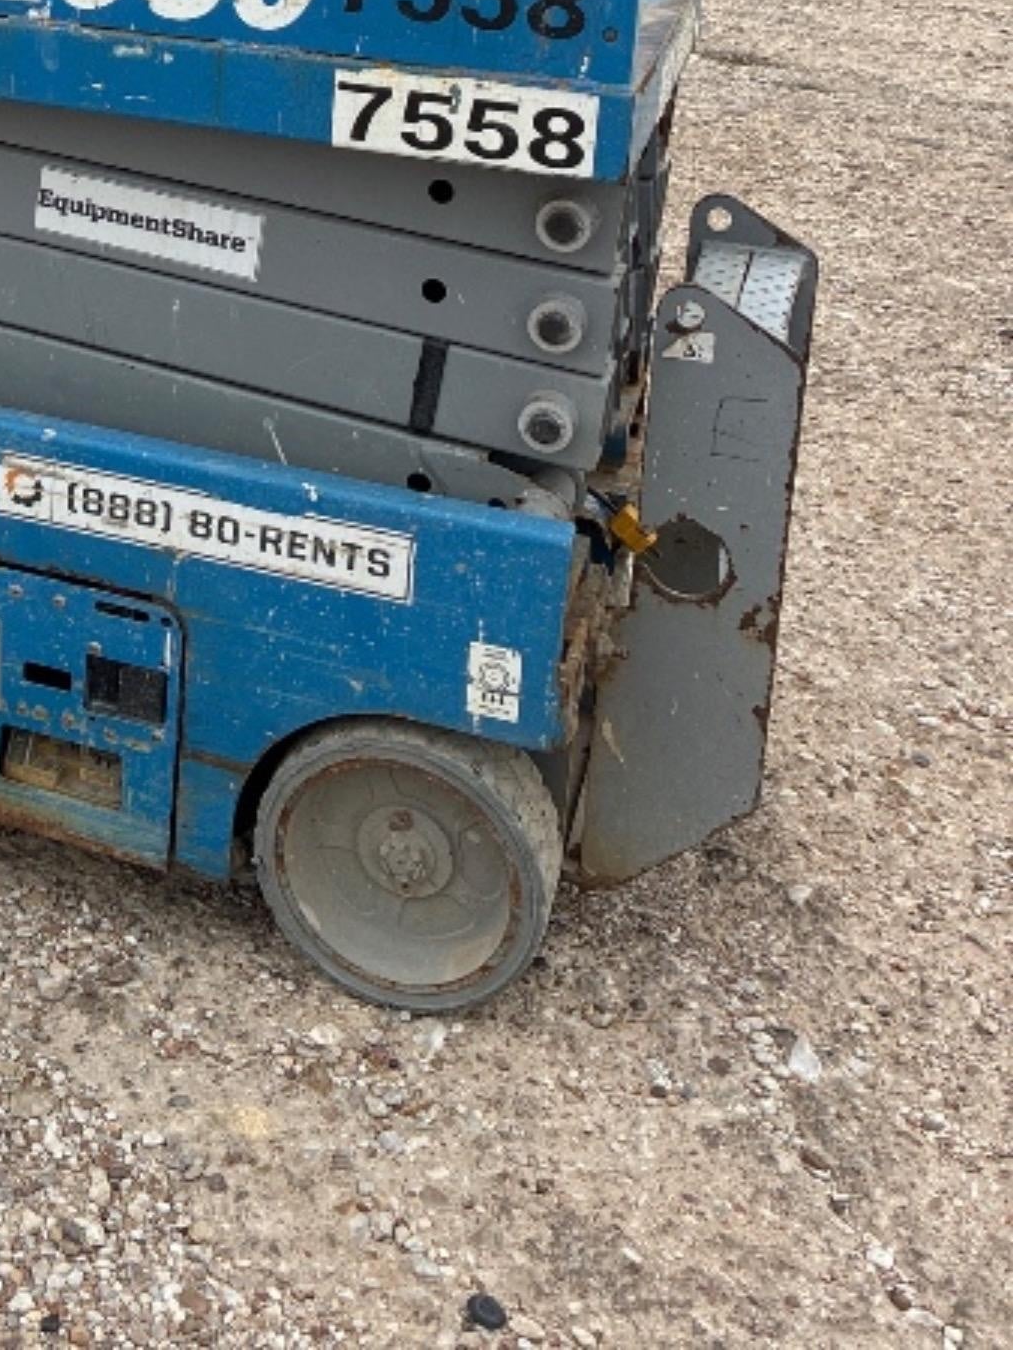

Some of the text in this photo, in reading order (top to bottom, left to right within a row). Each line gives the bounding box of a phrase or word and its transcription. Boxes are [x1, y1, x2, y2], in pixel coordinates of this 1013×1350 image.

[337, 81, 586, 169] 7558
[38, 188, 246, 252] EquipmentShare
[67, 481, 390, 579] (888) 80-RENTS
